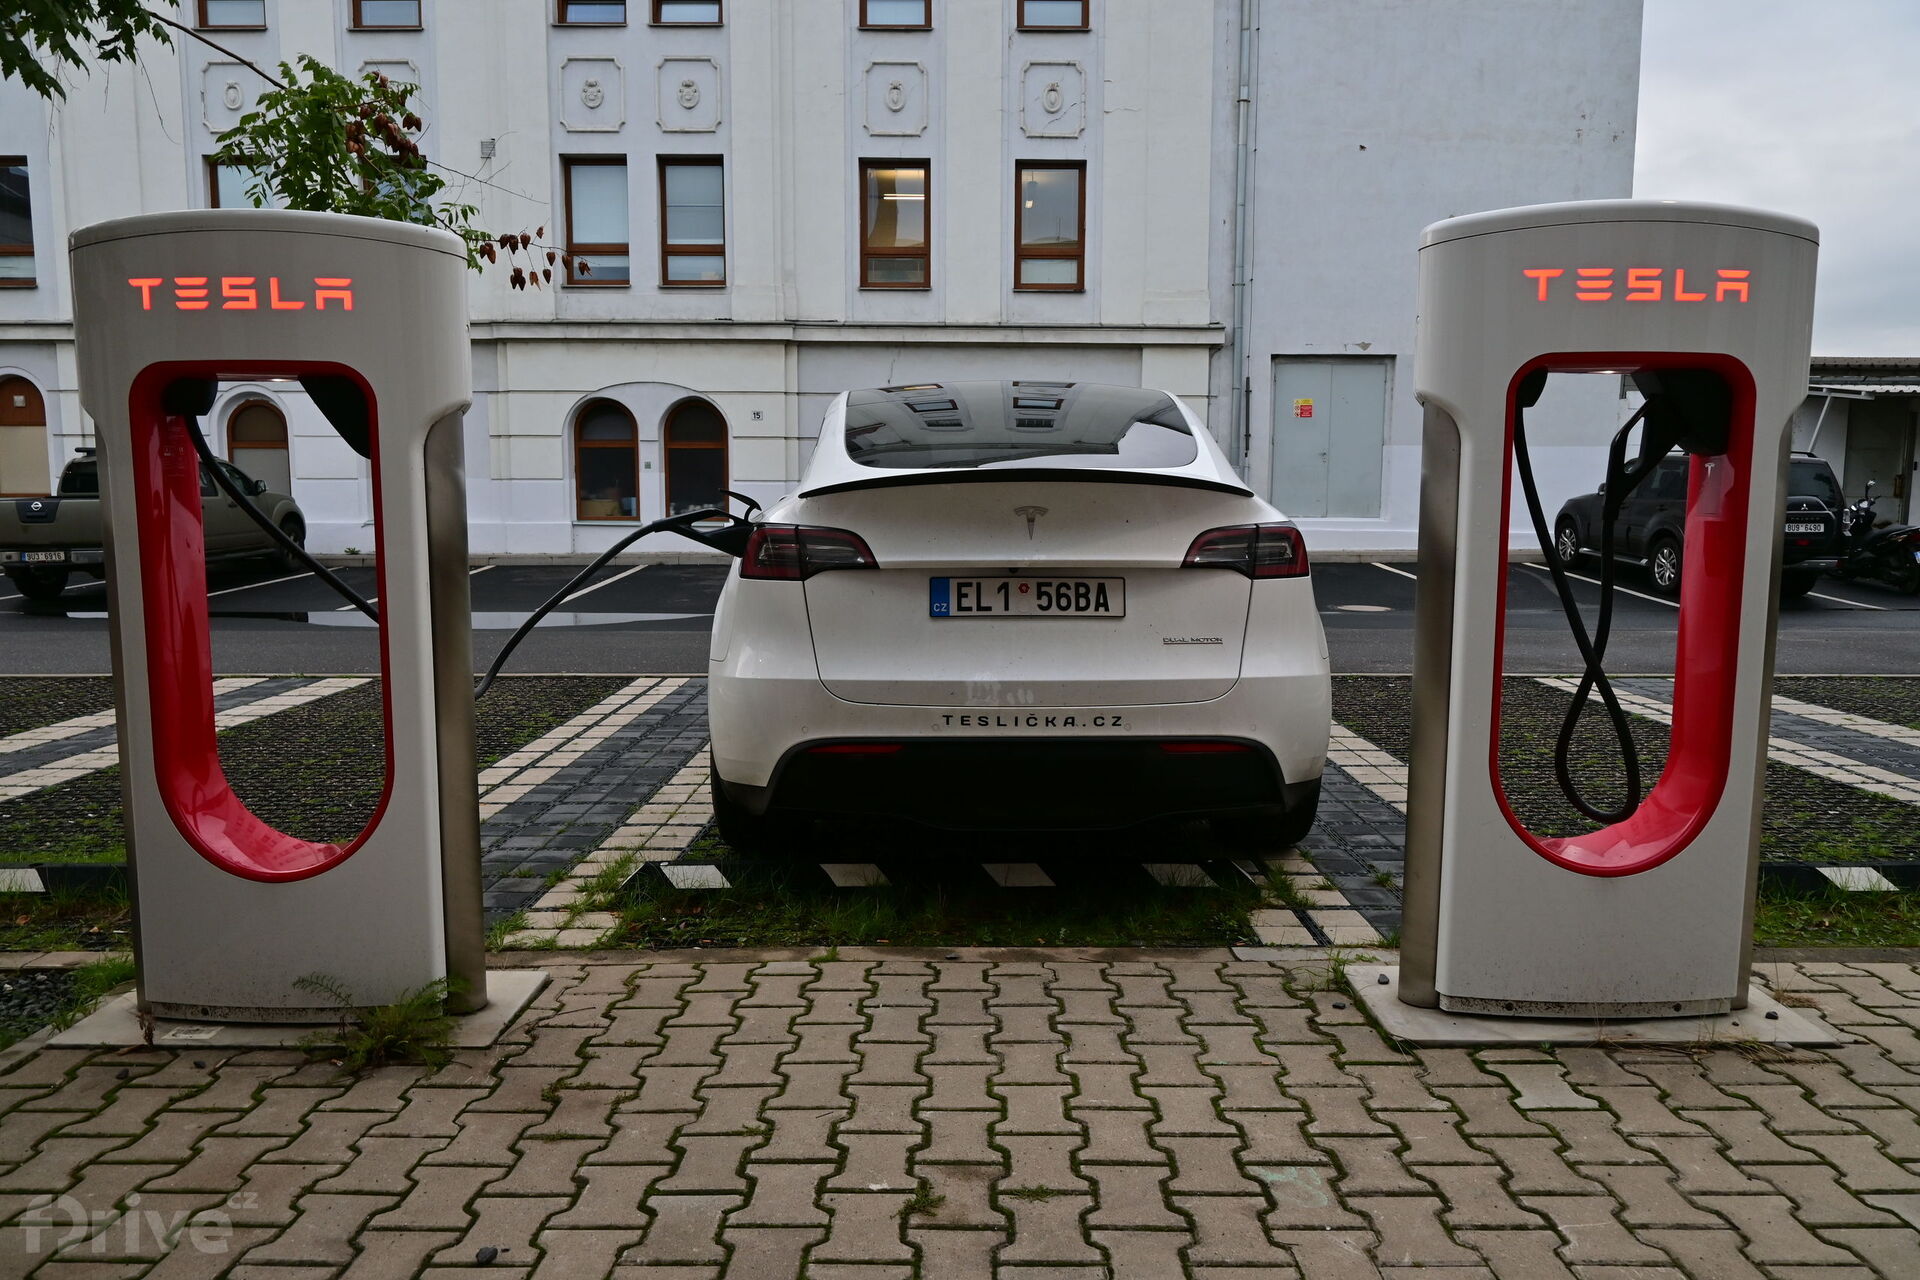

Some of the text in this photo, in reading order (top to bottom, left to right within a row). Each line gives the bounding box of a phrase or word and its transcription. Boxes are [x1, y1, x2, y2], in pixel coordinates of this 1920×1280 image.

[127, 276, 353, 311] TESLA
[1522, 268, 1750, 303] TESLA
[933, 602, 948, 613] CZ
[956, 581, 1110, 612] EL1 56BA
[942, 713, 1123, 727] TESLIČKA.CZ
